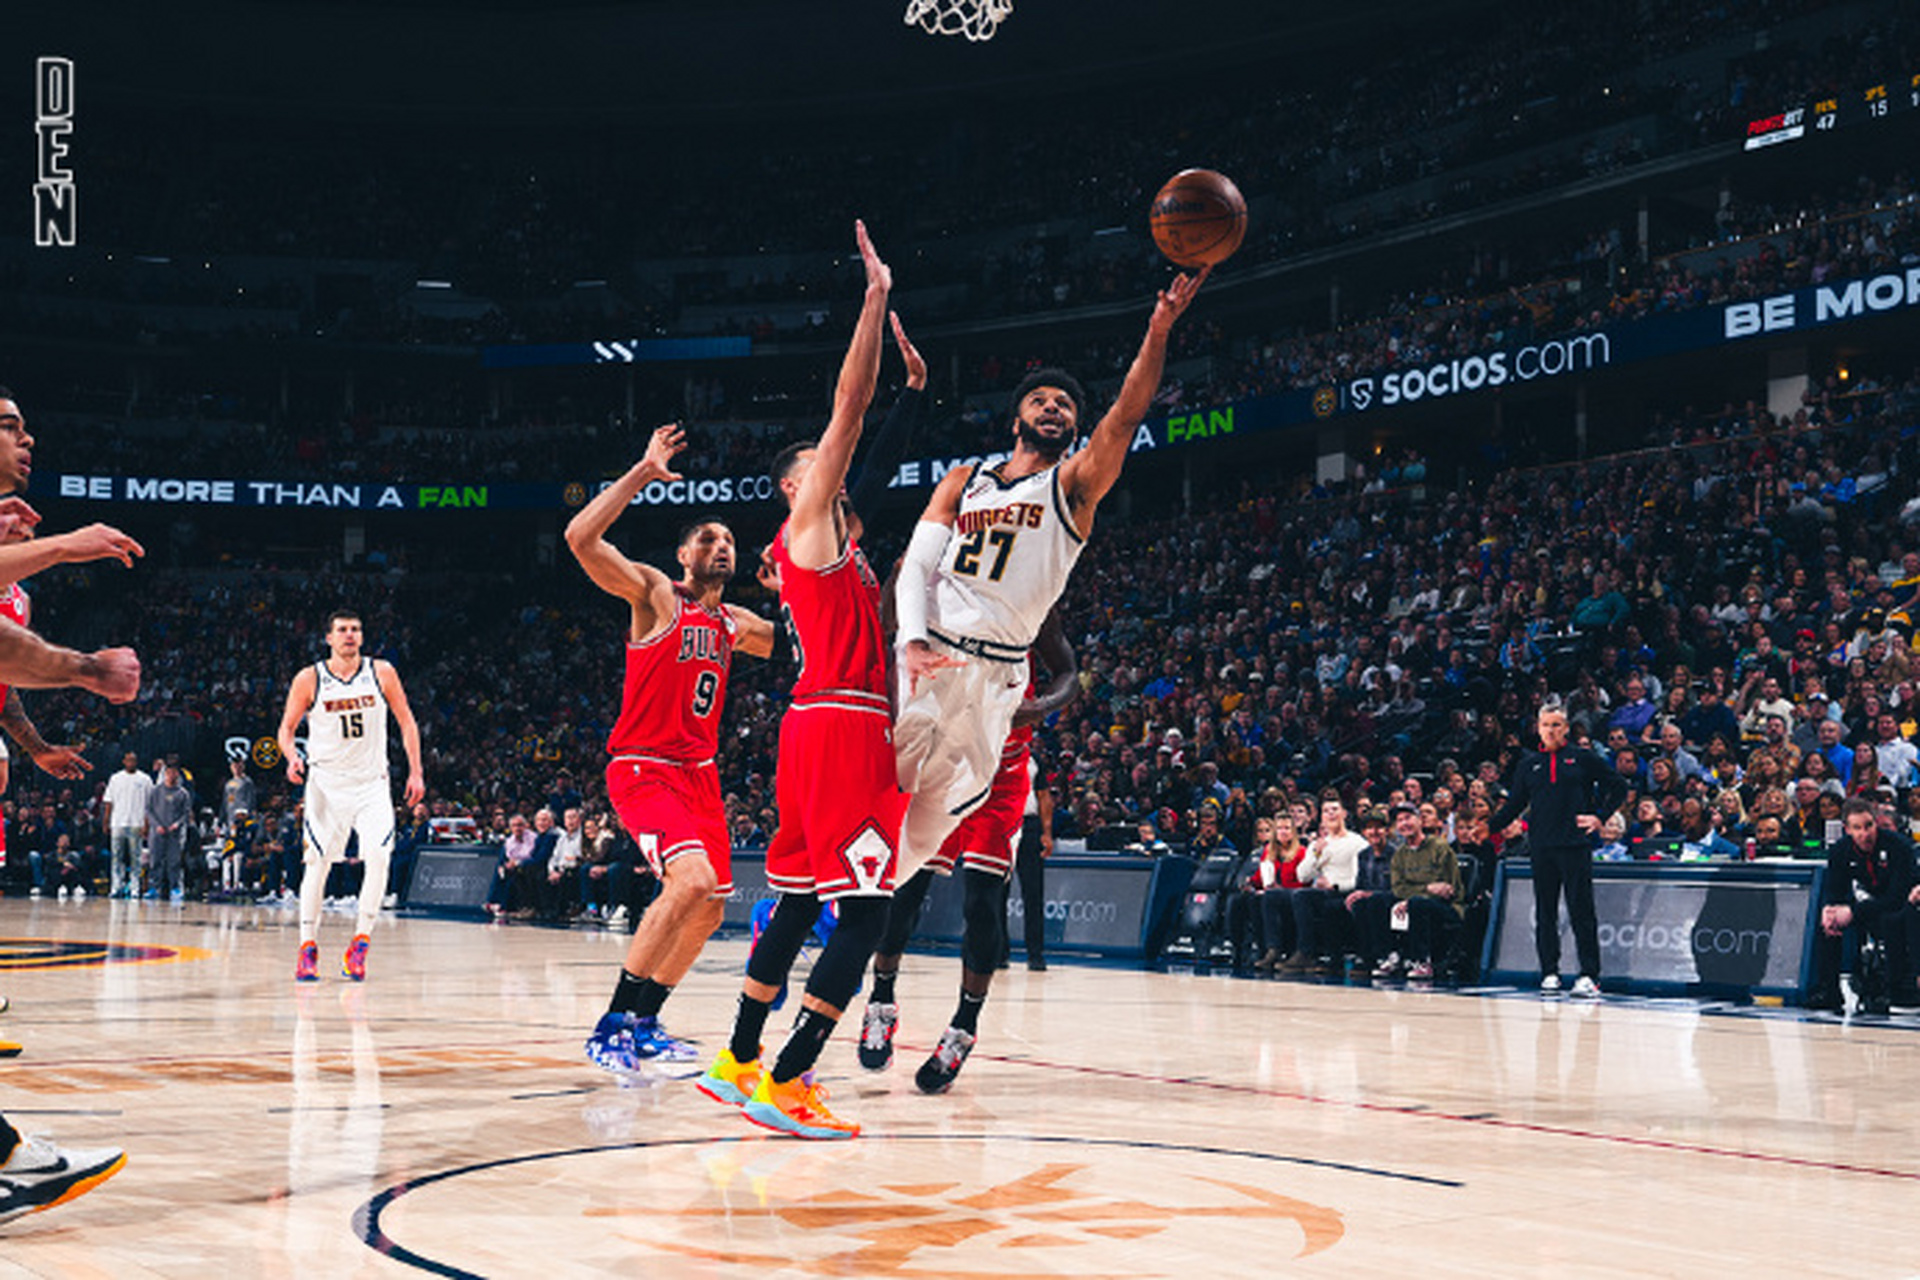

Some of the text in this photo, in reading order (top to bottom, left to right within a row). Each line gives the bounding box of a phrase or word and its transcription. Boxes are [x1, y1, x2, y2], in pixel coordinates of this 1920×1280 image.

[1816, 113, 1836, 130] 47
[1870, 100, 1888, 117] 15
[1724, 294, 1796, 338] BE
[1381, 333, 1610, 405] SOCIOS.com
[1167, 407, 1234, 443] FAN
[60, 475, 488, 508] BE MORE THAN A FAN
[953, 528, 1018, 582] 27
[692, 670, 719, 718] 9
[339, 712, 364, 739] 15
